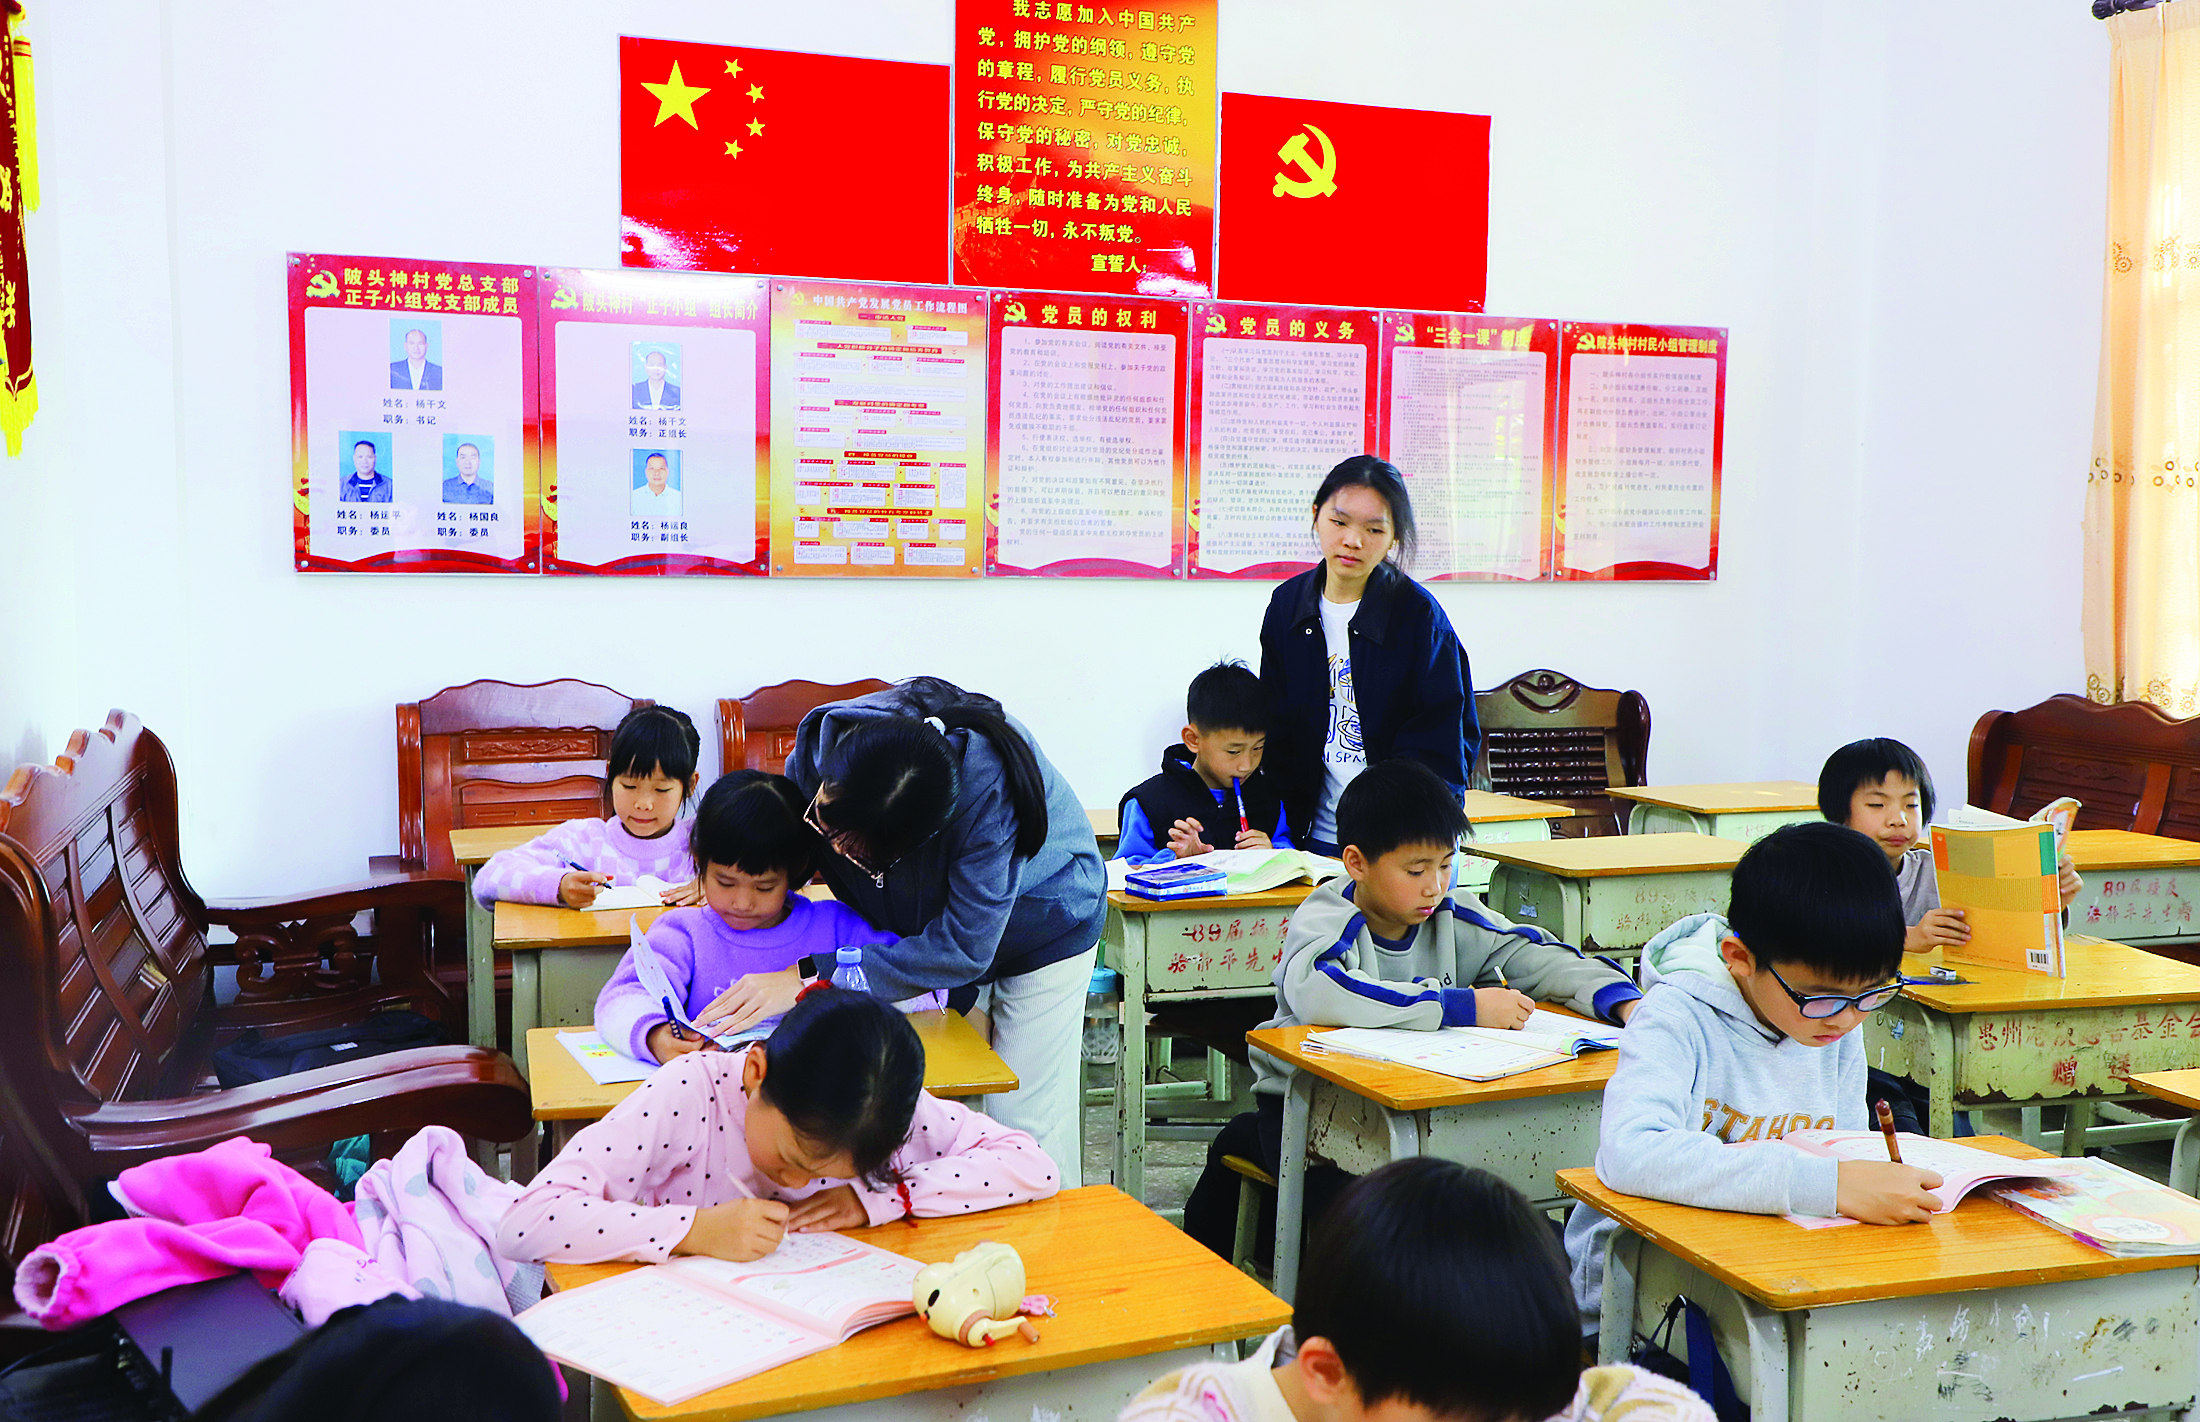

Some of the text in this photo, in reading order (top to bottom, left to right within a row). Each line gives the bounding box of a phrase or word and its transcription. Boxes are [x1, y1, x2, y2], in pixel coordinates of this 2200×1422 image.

[1013, 0, 1195, 33] 我志愿加入中国共产
[978, 27, 1195, 65] 党，拥护党的纲领，遵守党
[977, 59, 1194, 95] 的章程，履行党员义务，执
[977, 91, 1188, 126] 行党的决定，严守党的纪律，
[977, 122, 1187, 156] 保守党的秘密，对党忠诚，
[977, 153, 1192, 187] 积极工作，为共产主义奋斗
[976, 184, 1192, 216] 终身，随时准备为党和人民
[976, 215, 1141, 244] 牺牲一切，永不叛党。
[344, 268, 519, 294] 陂头神村党总支部
[345, 290, 519, 314] 正子小组党支部成员
[813, 294, 968, 314] 中国共产党发展党员工作流程图
[1042, 304, 1157, 329] 党员的权利
[1240, 316, 1355, 340] 党员的义务
[1427, 326, 1533, 347] “三会一课”制度
[1597, 335, 1718, 354] 陂头神村村民小组管理制度
